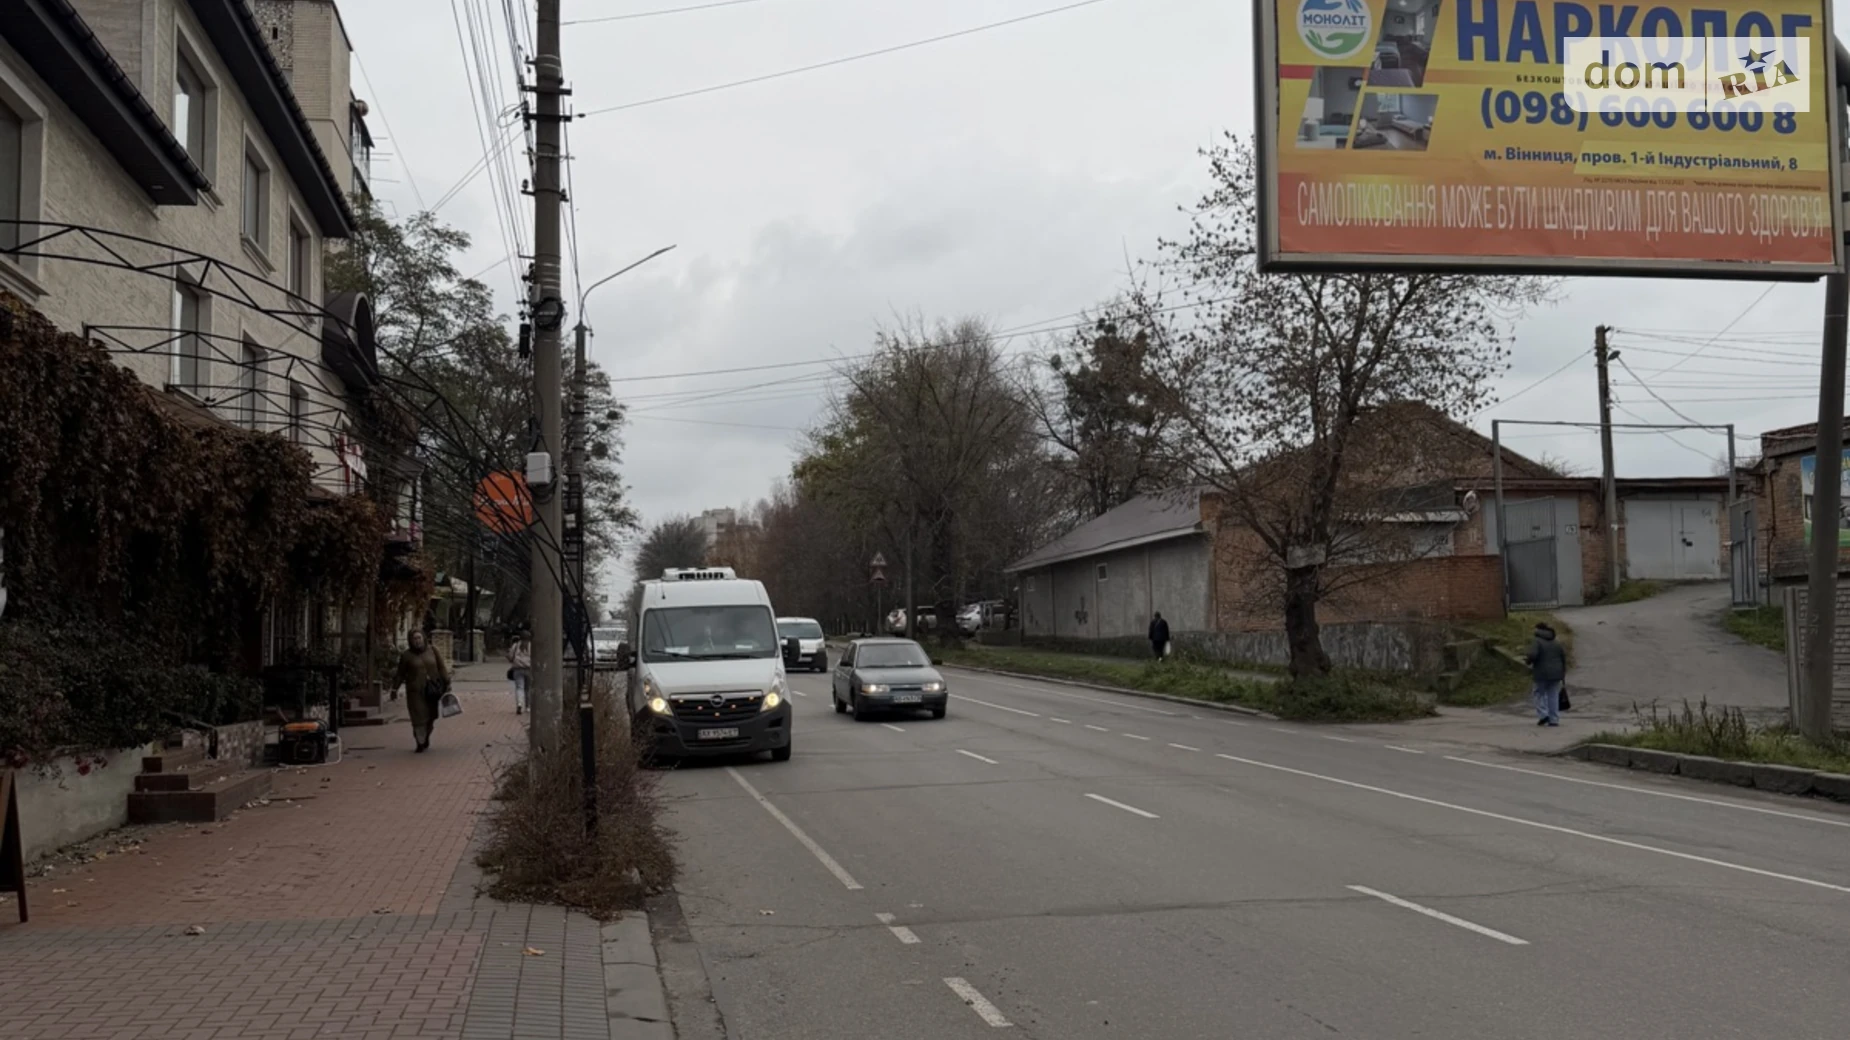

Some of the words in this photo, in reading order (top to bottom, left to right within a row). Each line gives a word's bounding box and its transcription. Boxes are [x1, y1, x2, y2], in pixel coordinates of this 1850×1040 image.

[1303, 13, 1367, 26] МОНОЛІТ
[1456, 0, 1812, 76] НАРКОЛОГ
[1481, 87, 1588, 132] (098)
[1599, 94, 1677, 128] 600
[1686, 97, 1764, 132] 600
[1772, 101, 1797, 135] 8
[1484, 149, 1502, 161] м.
[1506, 147, 1578, 165] Вінниця,
[1581, 152, 1627, 167] пров.
[1631, 151, 1655, 165] 1-й
[1659, 152, 1785, 171] Індустріальний,
[1789, 158, 1798, 170] 8
[1297, 181, 1437, 228] САМОЛІКУВАННЯ
[1441, 185, 1493, 230] МОЖЕ
[1497, 186, 1538, 231] БУТИ
[1543, 187, 1642, 240] ШКІДЛИВИМ
[1646, 190, 1679, 241] ДЛЯ
[1683, 193, 1745, 236] ВАШОГО
